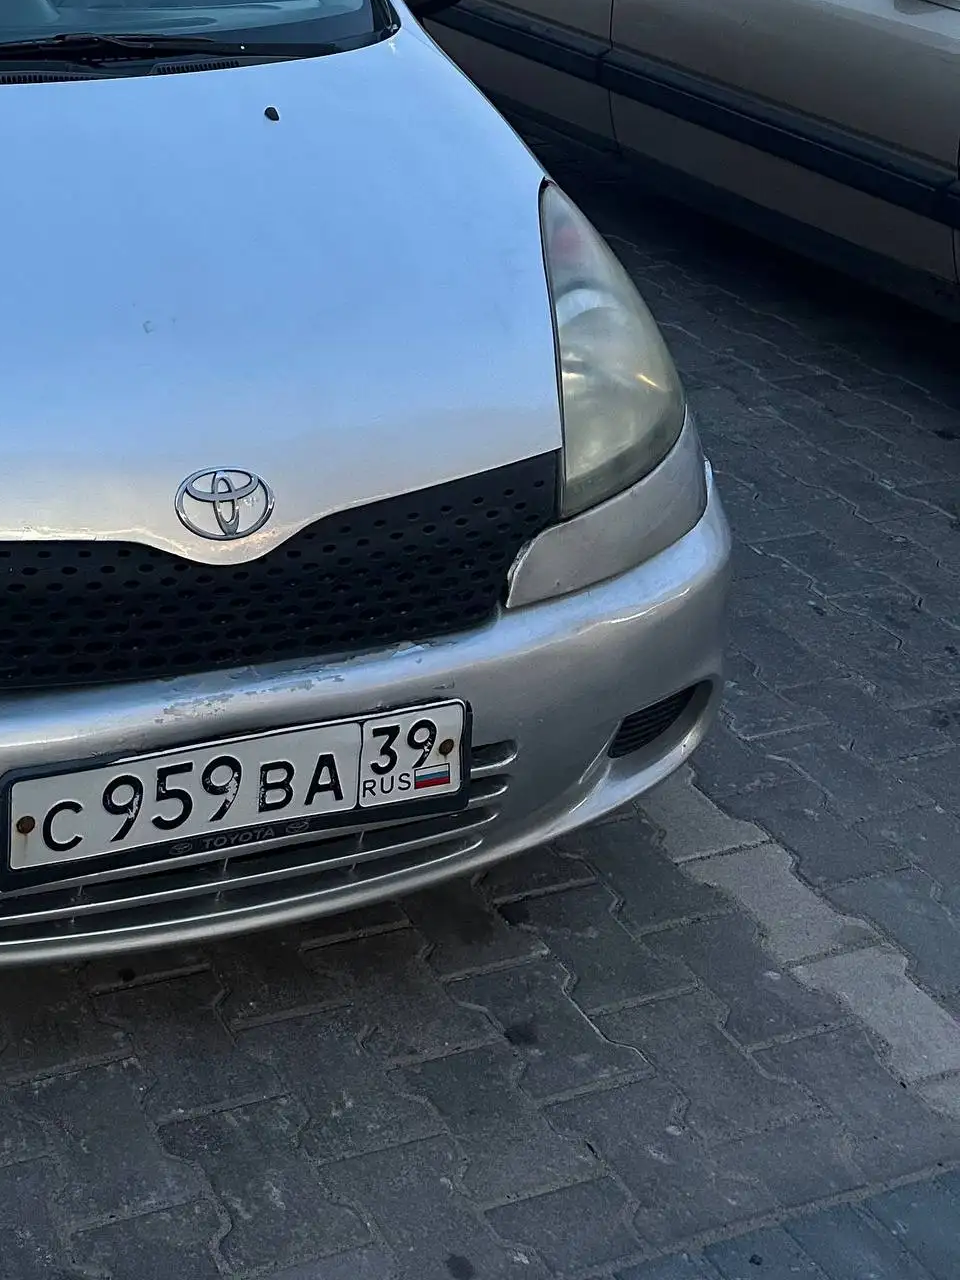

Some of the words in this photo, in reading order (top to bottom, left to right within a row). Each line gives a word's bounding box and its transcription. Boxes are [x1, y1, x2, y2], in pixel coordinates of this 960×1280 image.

[369, 718, 439, 776] 39
[362, 772, 412, 799] RUS
[202, 826, 275, 851] TOYOTA
